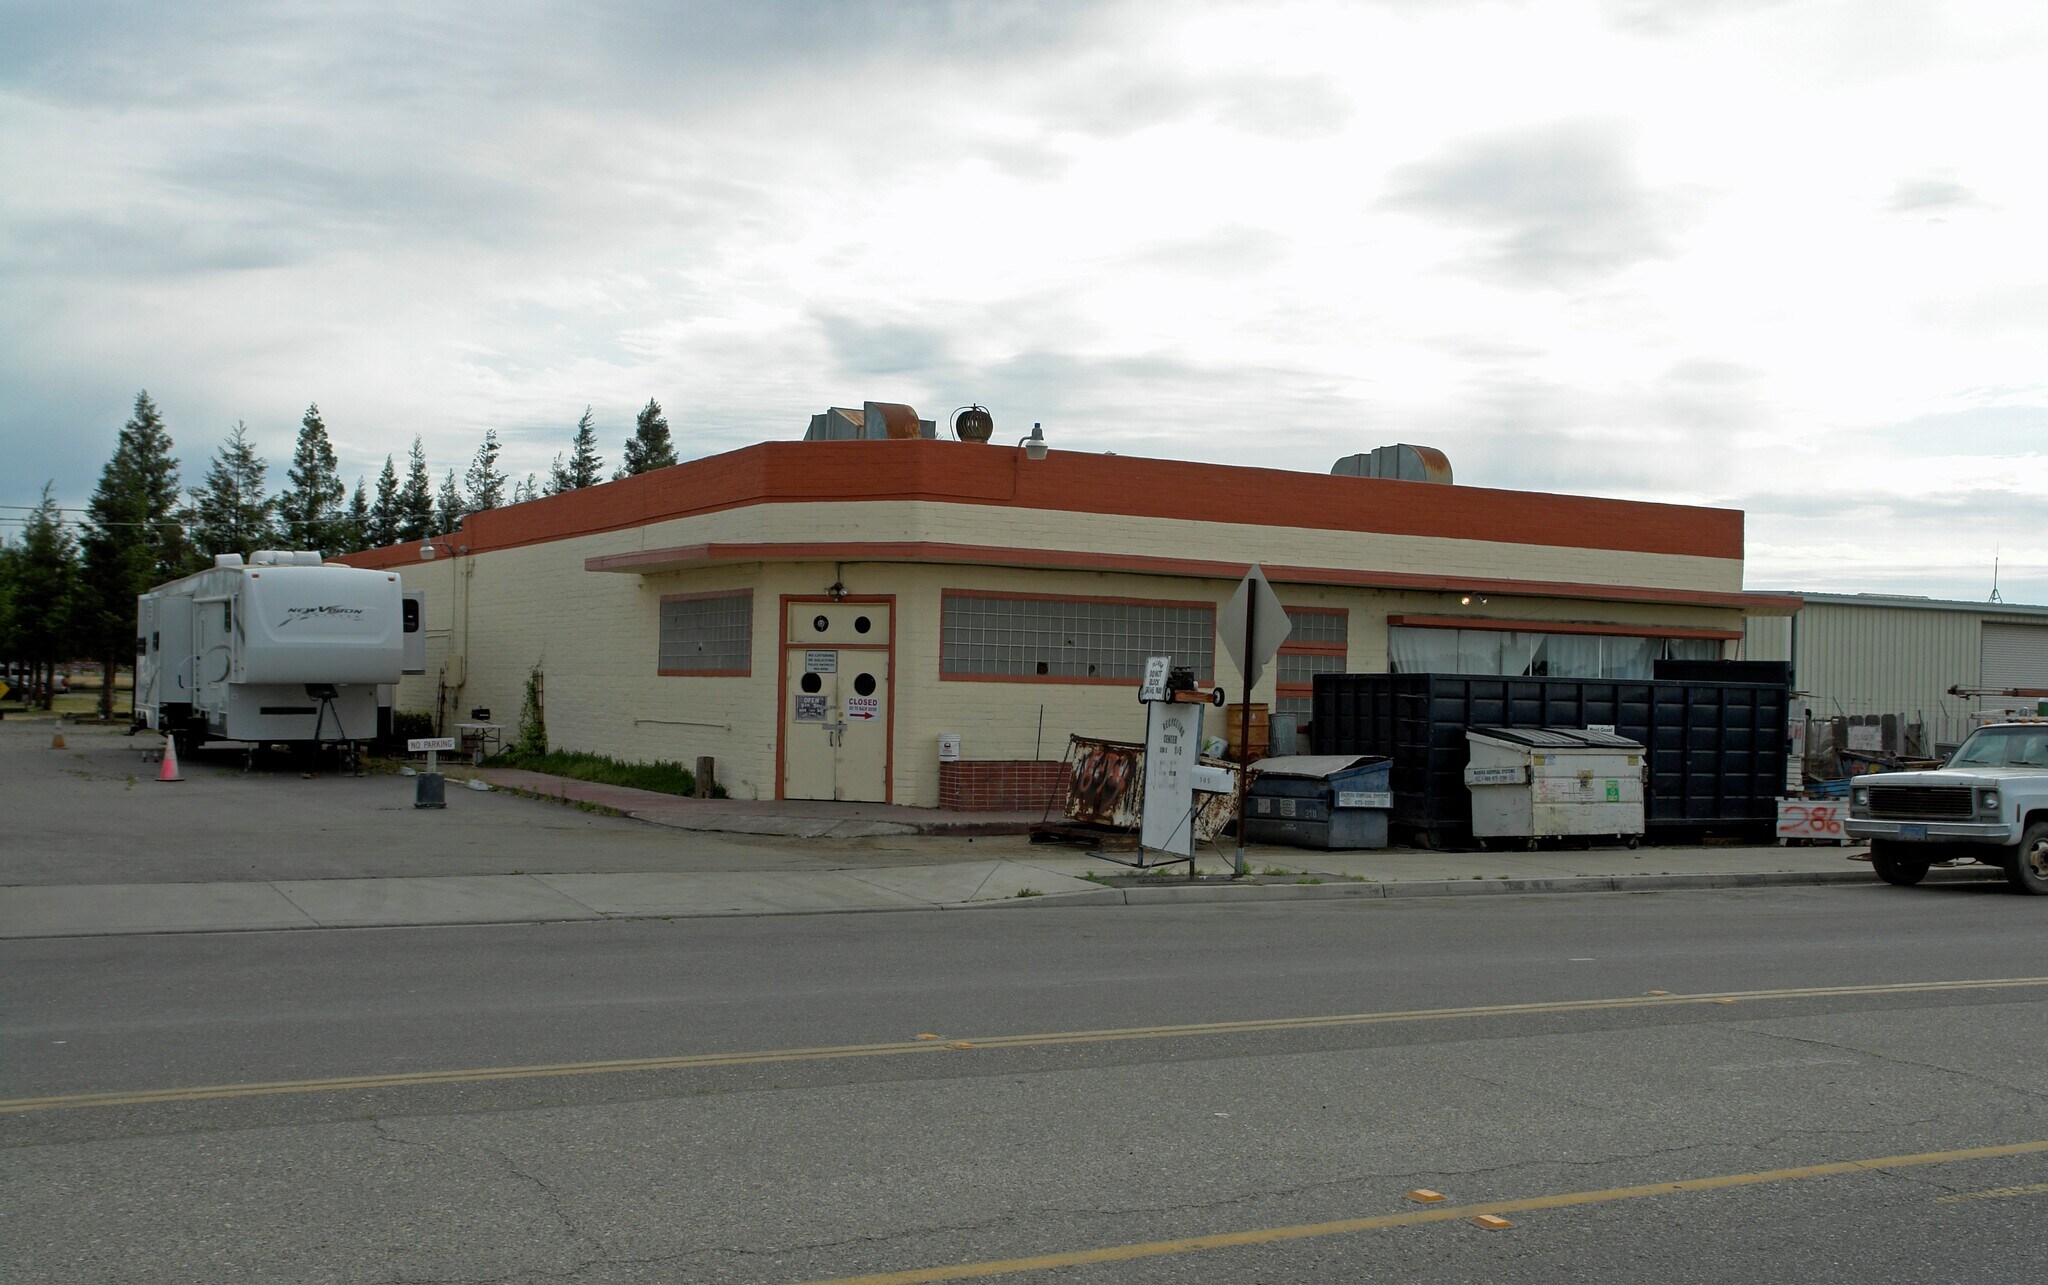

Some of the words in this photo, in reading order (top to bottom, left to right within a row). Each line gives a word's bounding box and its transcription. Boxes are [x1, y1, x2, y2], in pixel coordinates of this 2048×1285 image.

[849, 698, 878, 706] CLOSED
[1163, 718, 1185, 738] RECYCLING
[424, 740, 452, 748] PARKING
[1164, 734, 1178, 744] CENTER
[1780, 806, 1842, 834] 286
